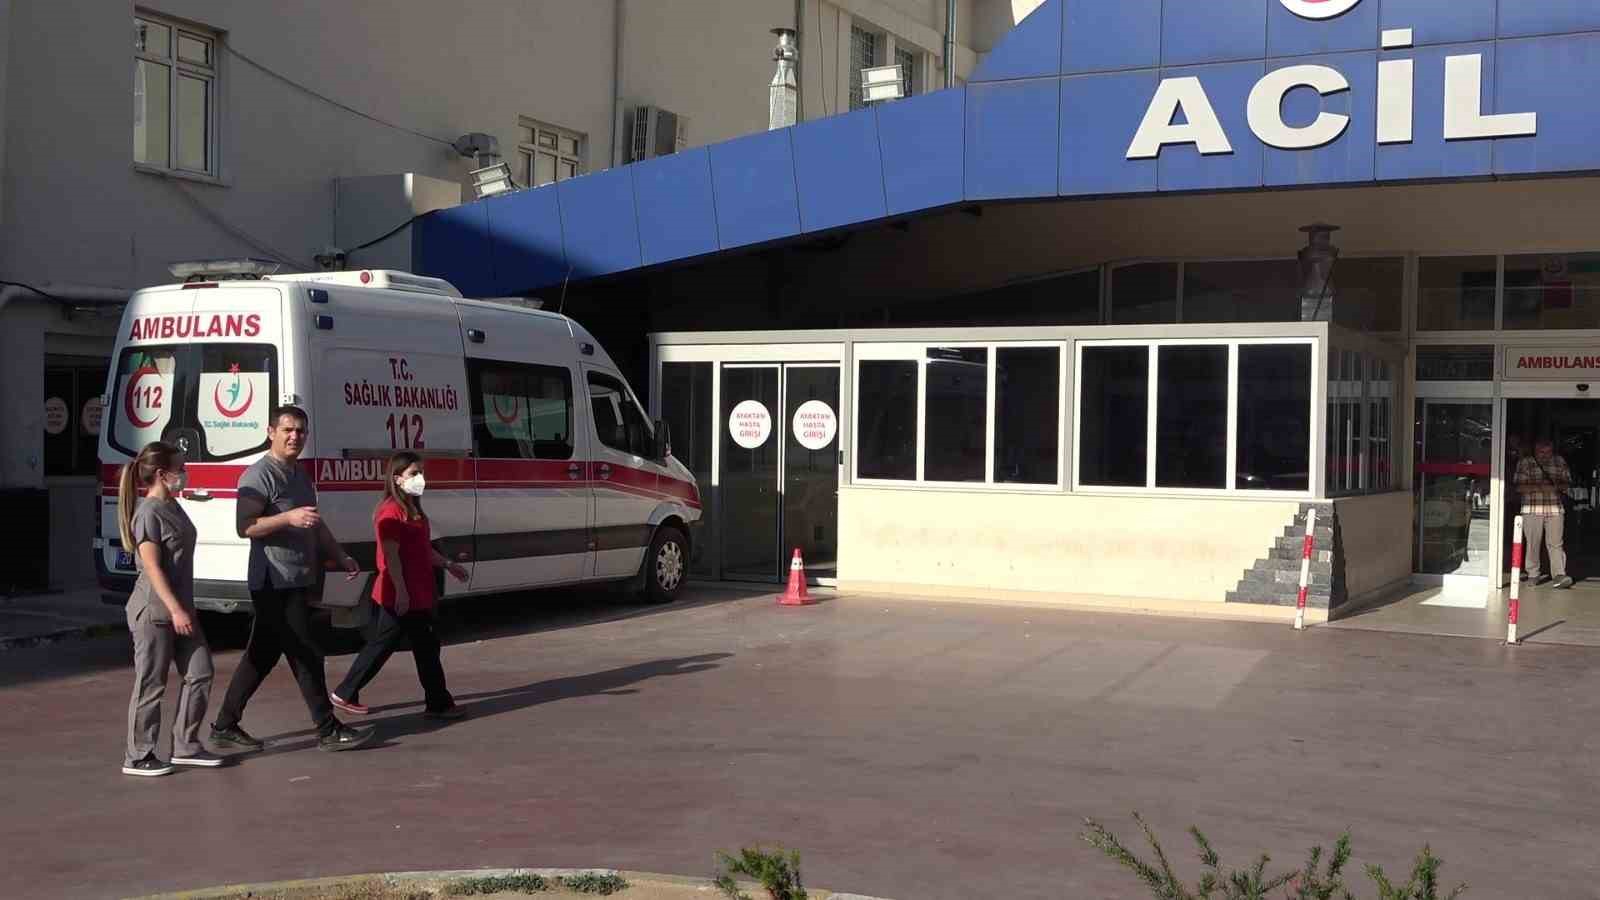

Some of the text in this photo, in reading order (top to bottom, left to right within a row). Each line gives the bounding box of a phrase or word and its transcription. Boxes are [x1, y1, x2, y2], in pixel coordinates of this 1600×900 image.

[1126, 28, 1537, 160] ACİL
[129, 313, 261, 341] AMBULANS
[389, 358, 413, 380] T.C.
[134, 386, 163, 409] 112
[344, 380, 458, 411] SAĞLIK BAKANLIĞI
[386, 413, 425, 449] 112
[320, 460, 385, 481] AMBUL
